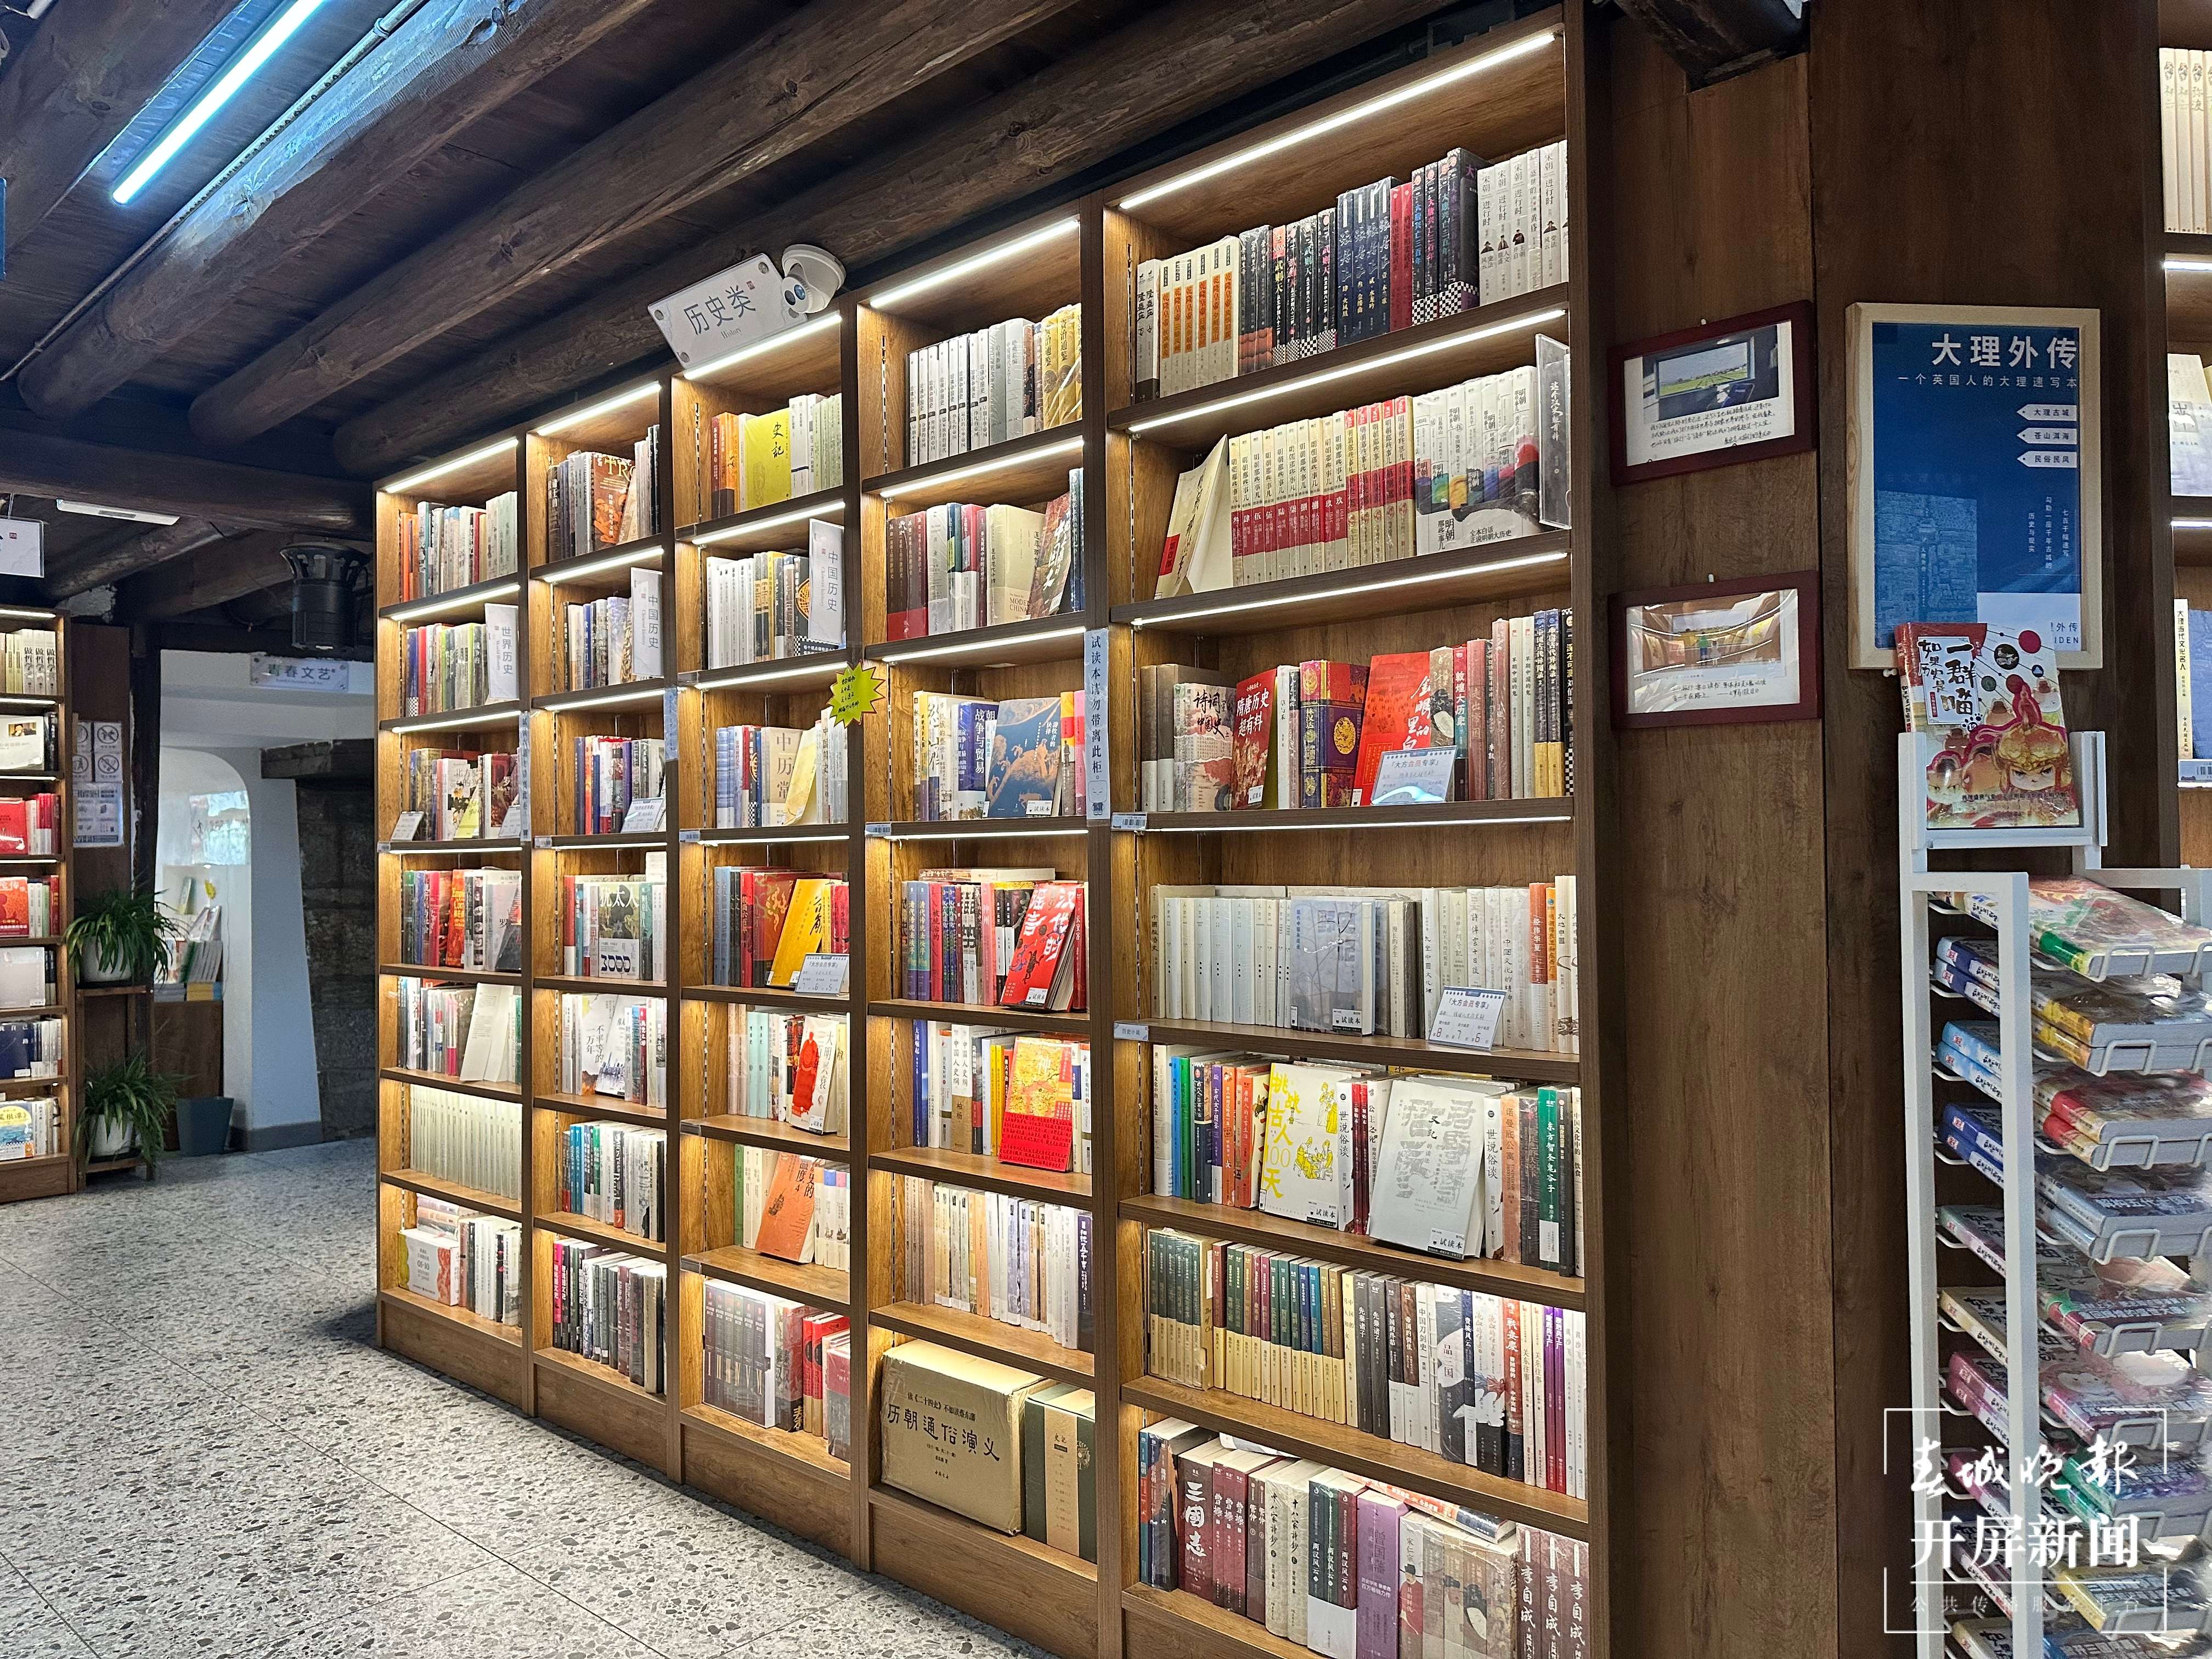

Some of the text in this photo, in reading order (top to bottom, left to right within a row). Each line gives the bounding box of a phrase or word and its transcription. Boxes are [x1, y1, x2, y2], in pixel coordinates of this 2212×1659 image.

[1498, 168, 1506, 221] 宋朝 进行时
[1514, 163, 1522, 215] 宋朝 进行时
[1545, 153, 1554, 205] 宋朝 进行时
[1482, 174, 1491, 226] 宋朝 进行时
[1274, 260, 1283, 294] 武则天
[1304, 246, 1312, 276] 武则天
[1322, 245, 1330, 276] 武则天
[684, 285, 756, 335] 历史类
[1932, 334, 2078, 369] 大理外传
[1898, 373, 2078, 388] 一个英国人的大理速写本
[2033, 408, 2070, 417] 大理古城
[2034, 431, 2070, 440] 苍山洱海
[2034, 455, 2070, 464] 民俗民风
[1437, 520, 1446, 551] 那些事儿
[1446, 518, 1455, 541] 明朝
[1470, 526, 1493, 536] 全本白话
[1470, 529, 1512, 544] 正说明朝大历史
[827, 551, 838, 612] 中国历史
[648, 594, 659, 649] 中国历史
[501, 626, 513, 675] 世界历史
[2177, 610, 2186, 670] 大理当代文化名人
[267, 664, 331, 680] 青春文艺
[1193, 689, 1221, 714] 诗词
[1237, 689, 1269, 717] 隋唐历史
[1454, 672, 1466, 726] 敦煌大历史
[974, 709, 985, 774] 战争与贸易
[1048, 720, 1057, 748] 游牧者的
[1197, 714, 1225, 739] 中国史
[1239, 713, 1263, 737] 超有料
[595, 1024, 605, 1063] 不平等的
[820, 1031, 833, 1090] 大明兴衰
[1339, 1110, 1350, 1158] 世说俗谈
[1505, 1107, 1515, 1161] 诺曼底公寓
[1487, 1128, 1498, 1180] 世说俗谈
[1546, 1121, 1557, 1193] 东方智圣鬼谷子
[1316, 1208, 1336, 1219] 试读本
[1440, 1237, 1462, 1250] 试读本
[1443, 1344, 1453, 1379] 品三国
[887, 1403, 1000, 1462] 历朝通俗演义
[1312, 1542, 1320, 1576] 两汉风云
[1521, 1565, 1536, 1629] 李自成
[1545, 1572, 1561, 1637] 李自成
[1570, 1580, 1585, 1646] 李自成
